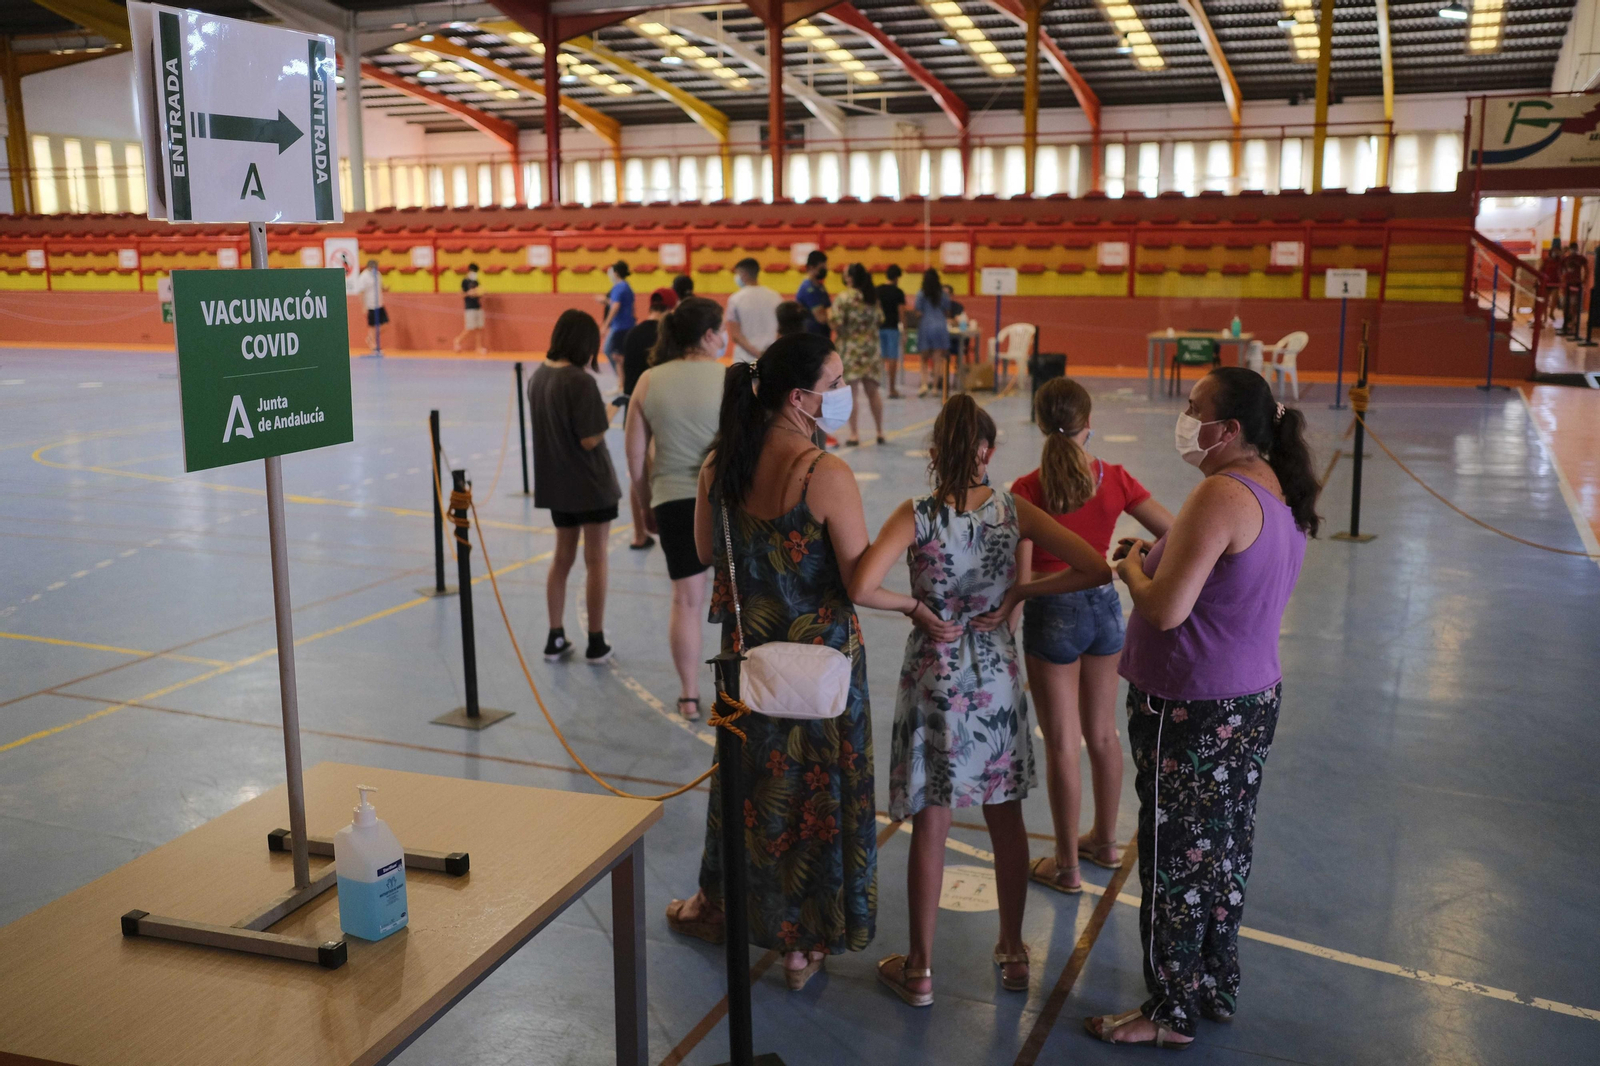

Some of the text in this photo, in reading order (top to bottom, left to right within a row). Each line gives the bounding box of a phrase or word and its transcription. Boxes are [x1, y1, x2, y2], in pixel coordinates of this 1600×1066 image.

[165, 57, 186, 177] ENTRADA
[312, 79, 329, 184] ENTRADA
[240, 162, 266, 200] A
[200, 289, 328, 326] VACUNACIÓN
[241, 332, 300, 360] COVID
[222, 394, 254, 443] A
[257, 395, 288, 412] Junta
[258, 406, 325, 432] de Andalucía
